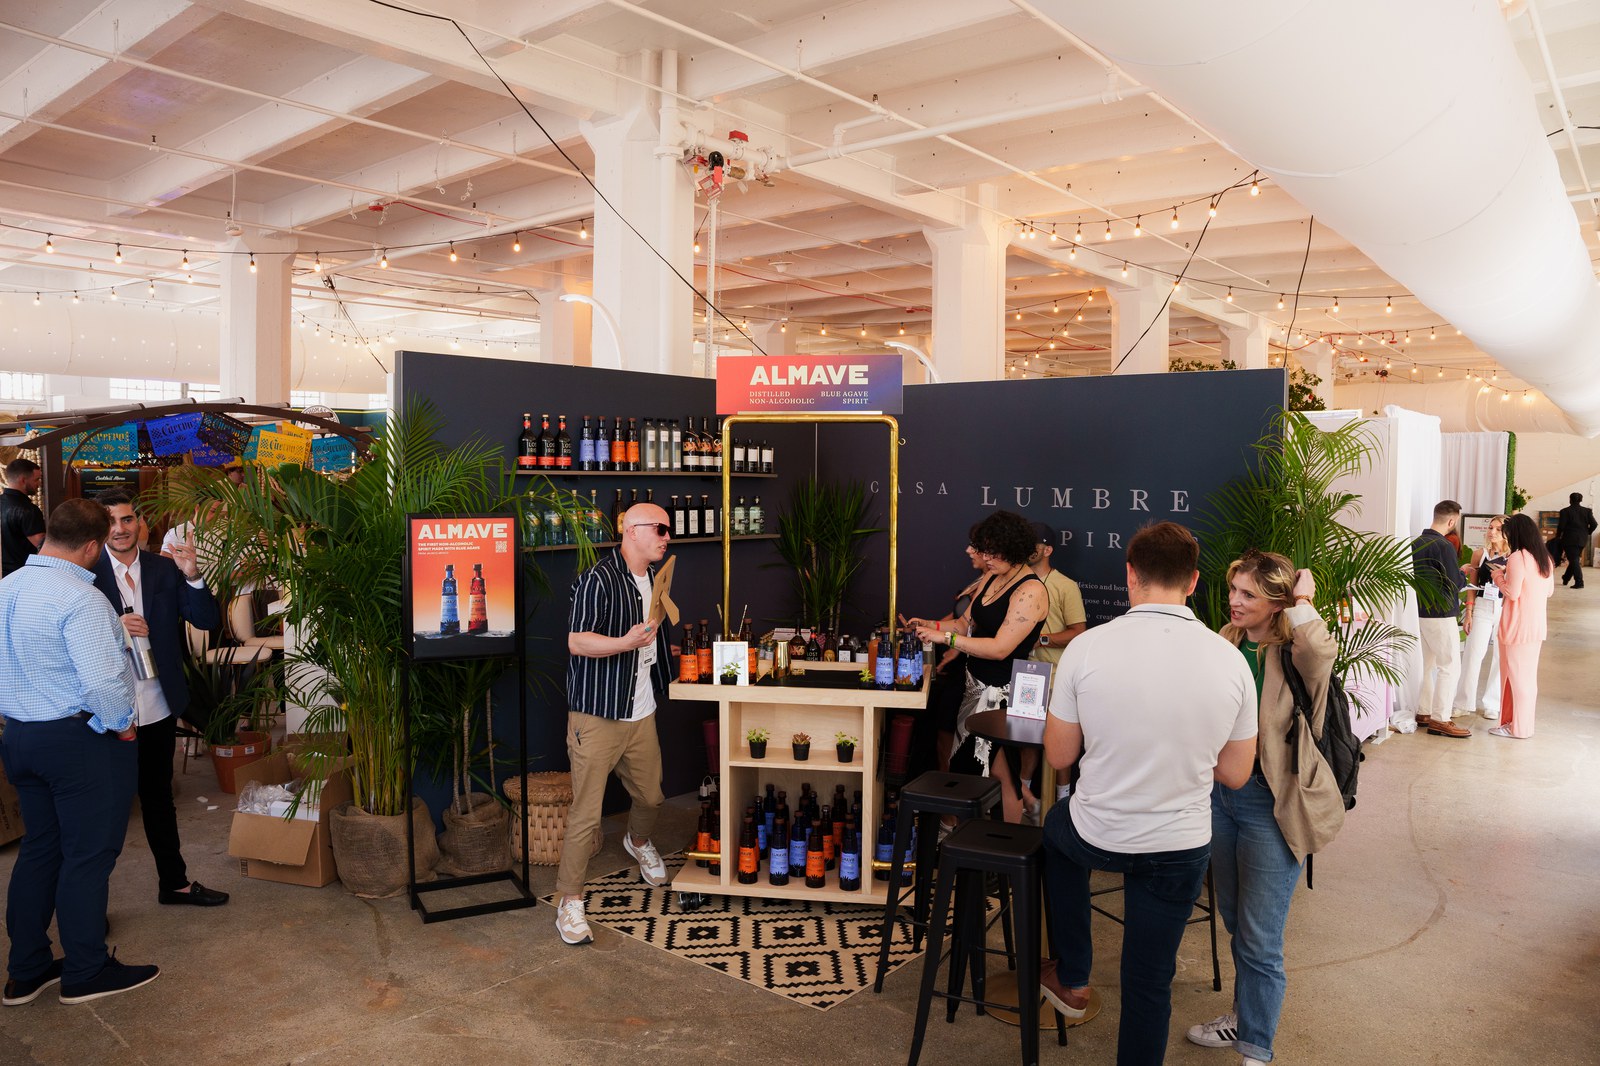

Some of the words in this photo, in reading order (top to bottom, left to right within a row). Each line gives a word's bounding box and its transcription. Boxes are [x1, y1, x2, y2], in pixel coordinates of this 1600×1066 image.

[749, 364, 869, 386] ALMAVE
[749, 390, 791, 398] DISTILLED
[820, 390, 842, 398] BLUE
[842, 390, 869, 398] AGAVE
[749, 397, 815, 405] NON-ALCOHOLIC
[842, 397, 869, 405] SPIRIT
[980, 485, 1190, 513] LUMBRE
[418, 523, 508, 540] ALMAVE
[1099, 583, 1113, 591] and
[1113, 599, 1130, 607] chall
